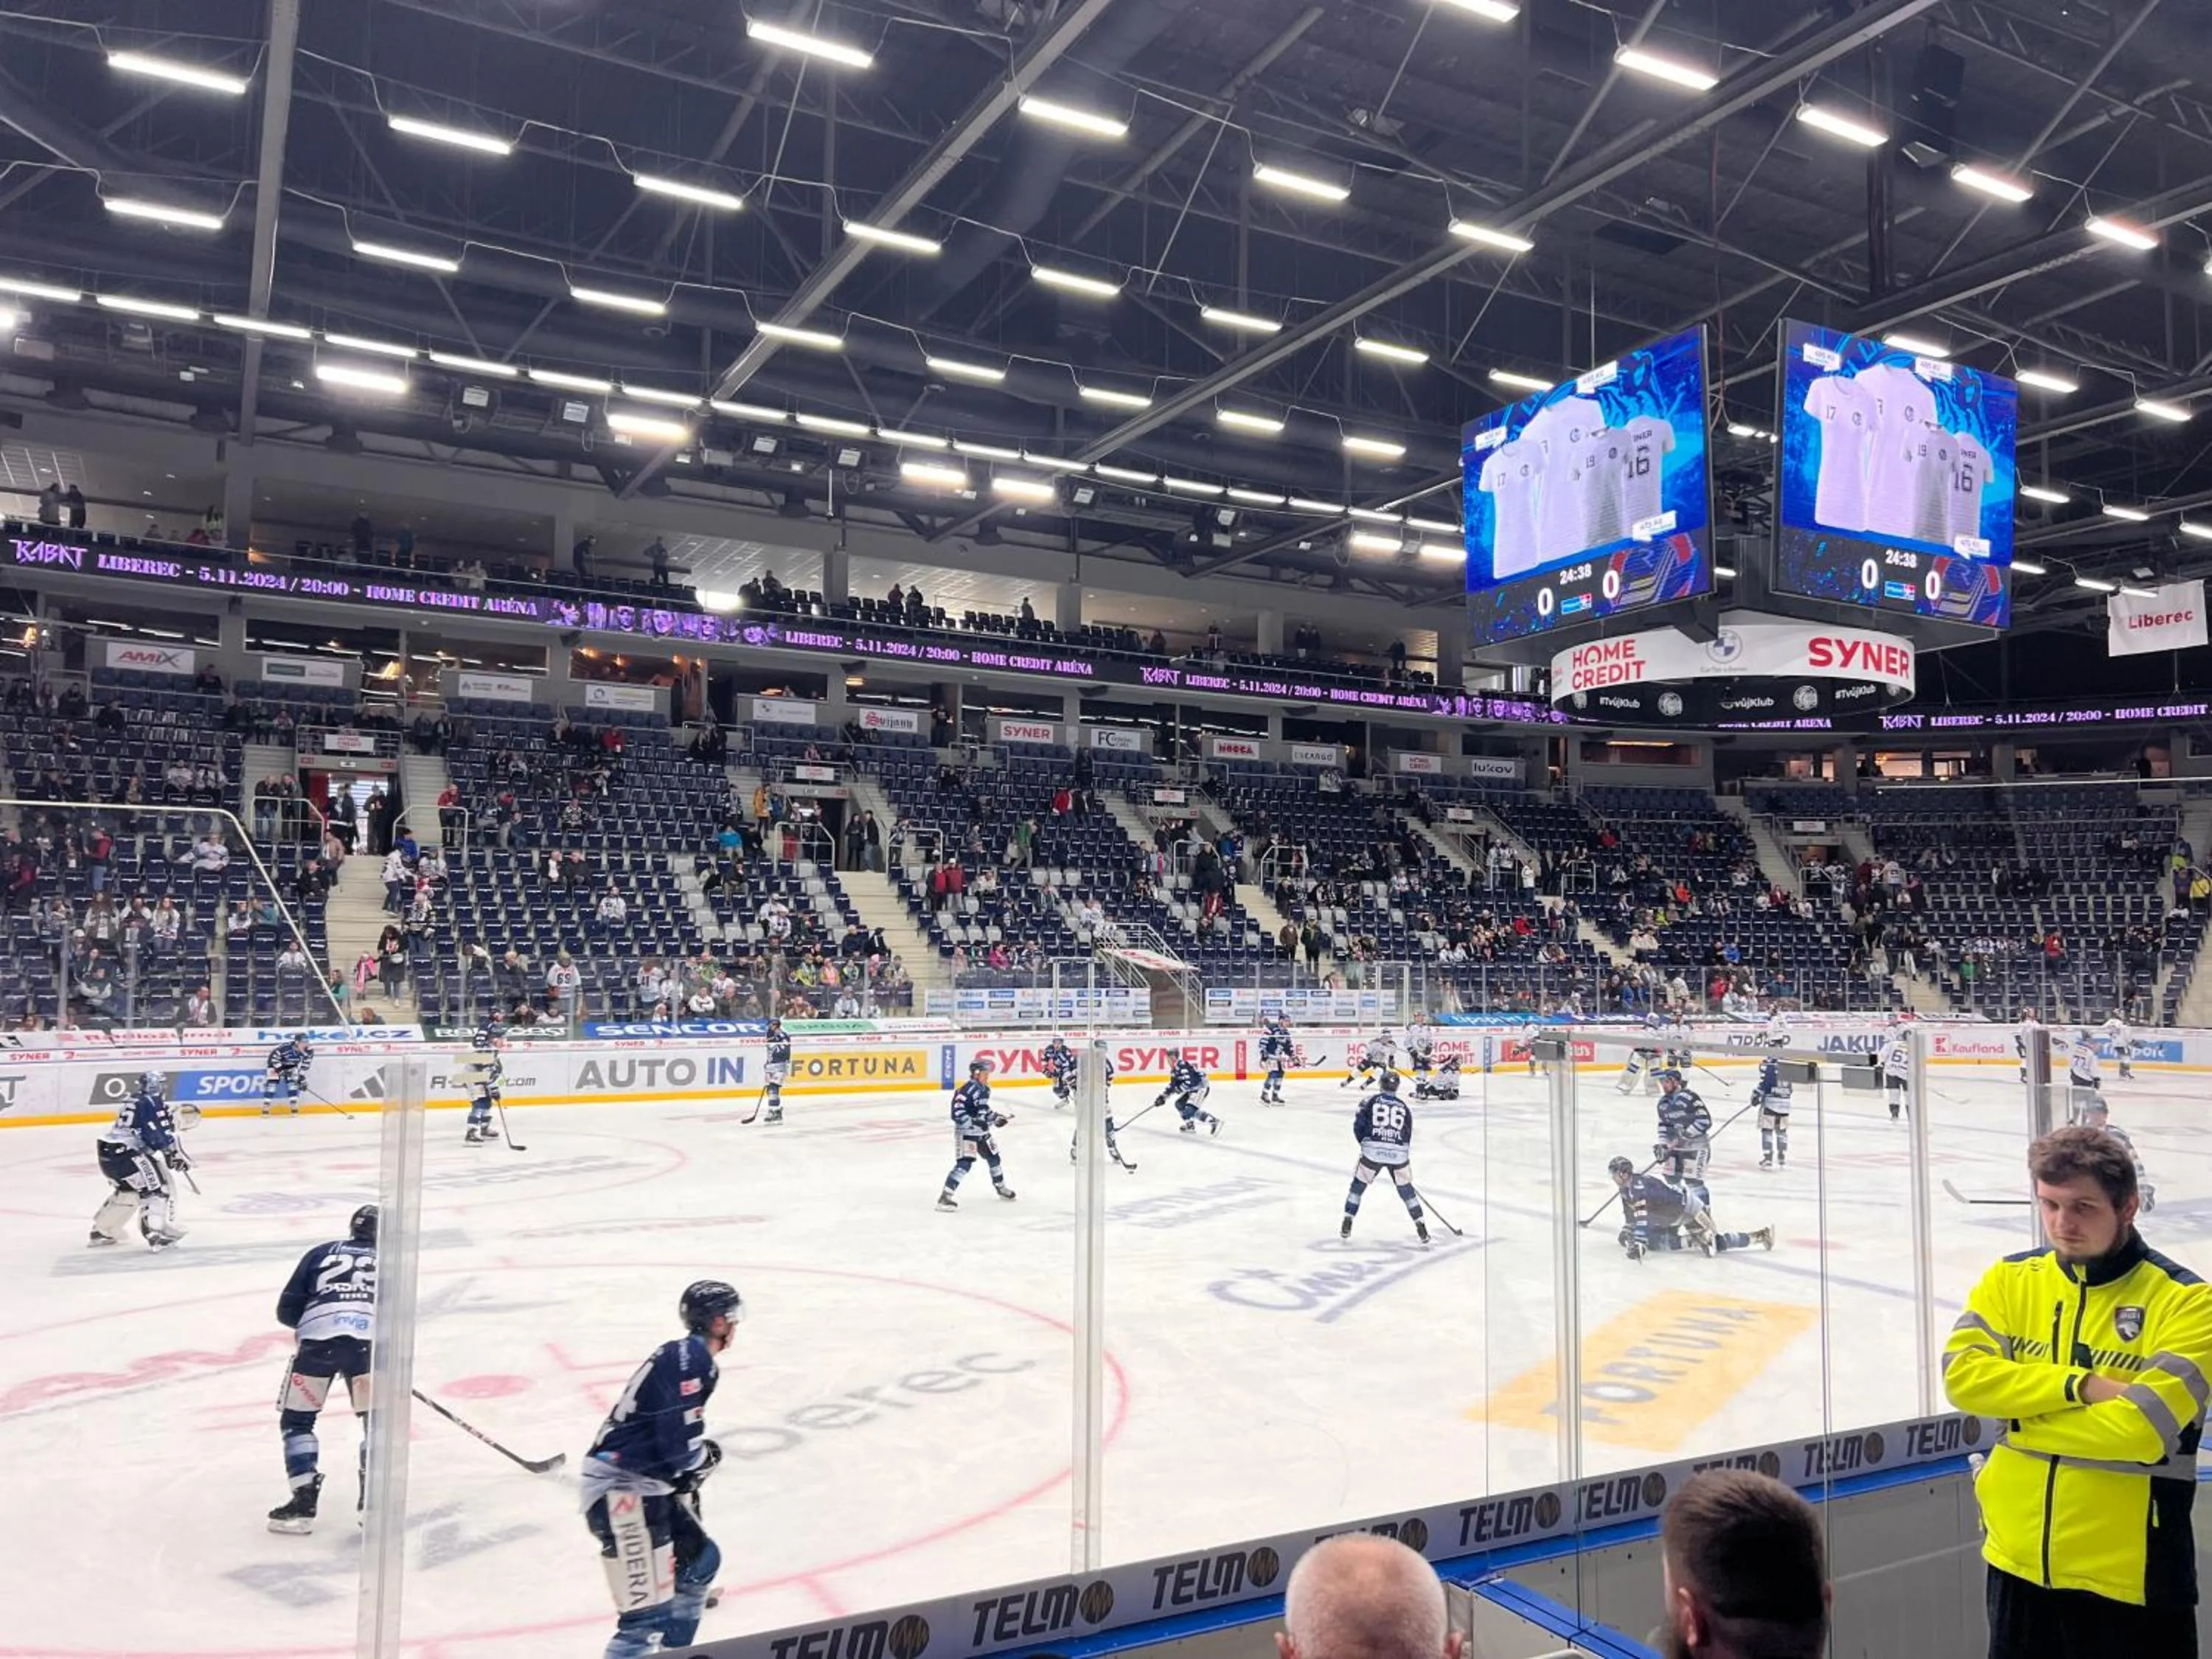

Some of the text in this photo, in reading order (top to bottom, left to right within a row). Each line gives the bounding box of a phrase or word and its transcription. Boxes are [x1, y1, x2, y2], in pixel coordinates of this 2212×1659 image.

[1885, 549, 1916, 568] 24:38
[97, 554, 181, 577] LIBEREC
[199, 566, 286, 589] 5.11.2024
[300, 578, 349, 596] 20:00
[366, 585, 416, 602] HOME
[420, 591, 480, 610] CREDIT
[1559, 564, 1593, 585] 24:38
[1602, 571, 1620, 599] 0
[1861, 559, 1879, 588] 0
[1925, 571, 1940, 599] 0
[1537, 588, 1554, 616] 0
[2129, 610, 2194, 629] Liberec
[119, 650, 184, 667] AMIX
[785, 630, 843, 648] LIBEREC
[855, 639, 917, 657] 5.11.2024
[926, 647, 960, 661] 20:00
[971, 651, 1006, 666] HOME
[1009, 655, 1053, 670] CREDIT
[1572, 639, 1636, 669] HOME
[1809, 637, 1910, 679] SYNER
[1573, 661, 1646, 690] CREDIT
[1186, 674, 1231, 689] LIBEREC
[1239, 680, 1287, 694] 5.11.2024
[1295, 686, 1321, 698] 20:00
[1330, 688, 1359, 700] HOME
[1360, 692, 1394, 706] CREDIT
[1930, 715, 1983, 726] LIBEREC
[1994, 712, 2056, 725] 5.11.2024
[2066, 710, 2102, 722] 20:00
[2115, 708, 2154, 719] HOME
[2157, 704, 2208, 717] CREDIT
[1004, 726, 1051, 739] SYNER
[595, 1022, 766, 1036] SENCOR
[10, 1052, 50, 1060] SYNER
[180, 1048, 218, 1057] SYNER
[1952, 1043, 2004, 1054] Kaufland
[575, 1057, 745, 1089] AUTO IN
[790, 1057, 916, 1077] FORTUNA
[196, 1074, 266, 1094] SPOR
[1372, 1103, 1406, 1130] 86
